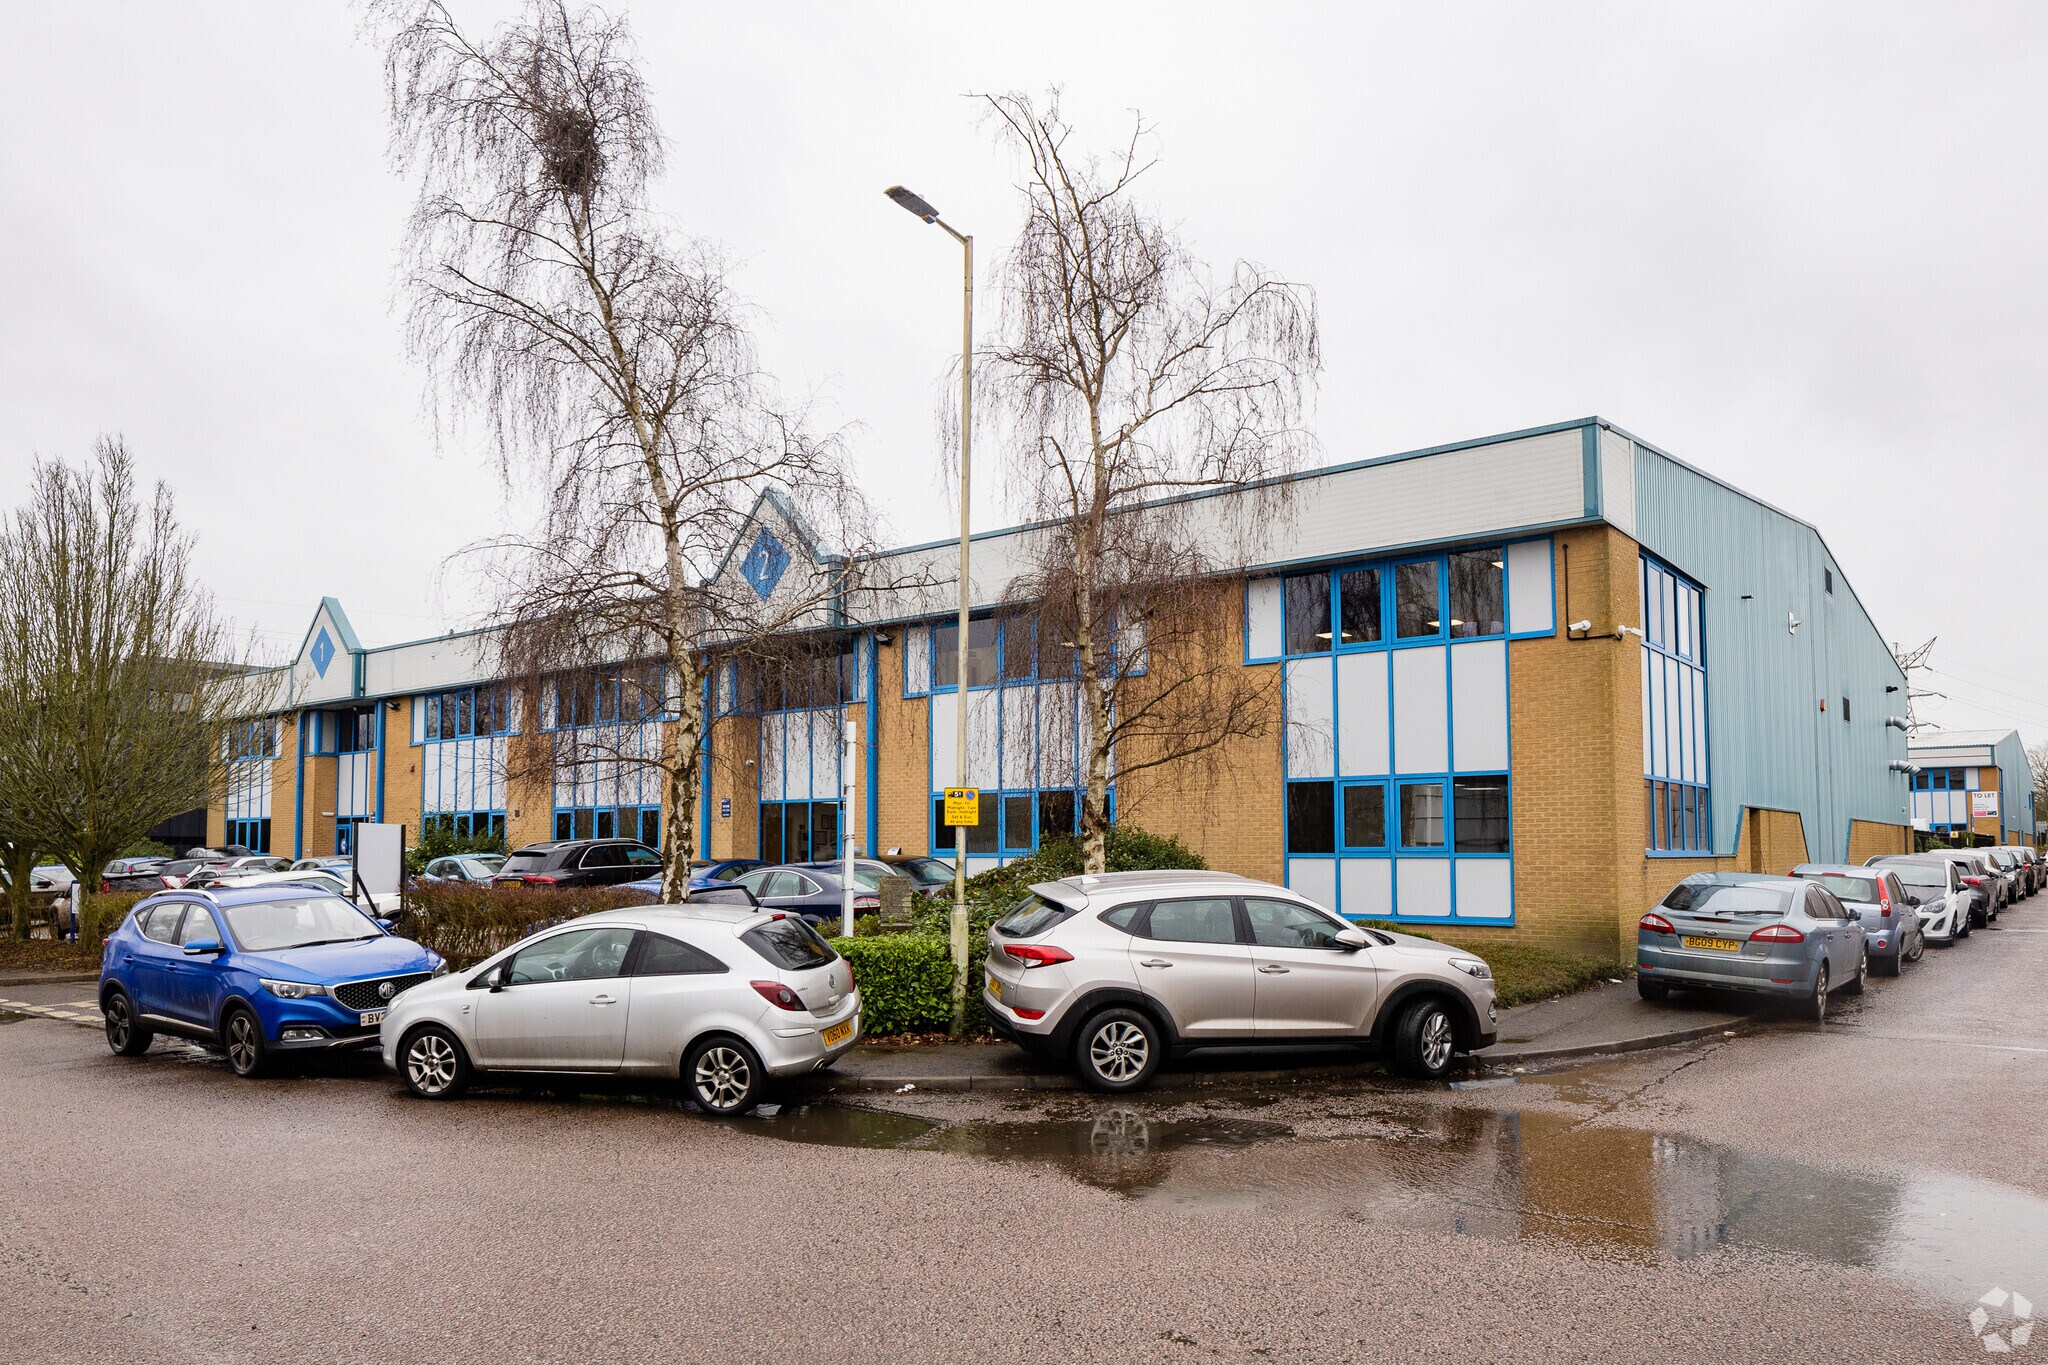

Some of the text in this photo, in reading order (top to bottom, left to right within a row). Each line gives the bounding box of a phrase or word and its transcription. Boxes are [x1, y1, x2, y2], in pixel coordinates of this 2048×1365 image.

[759, 548, 769, 581] 2
[319, 641, 325, 663] 1
[1688, 937, 1735, 950] BG09 CYP
[379, 982, 396, 999] MG
